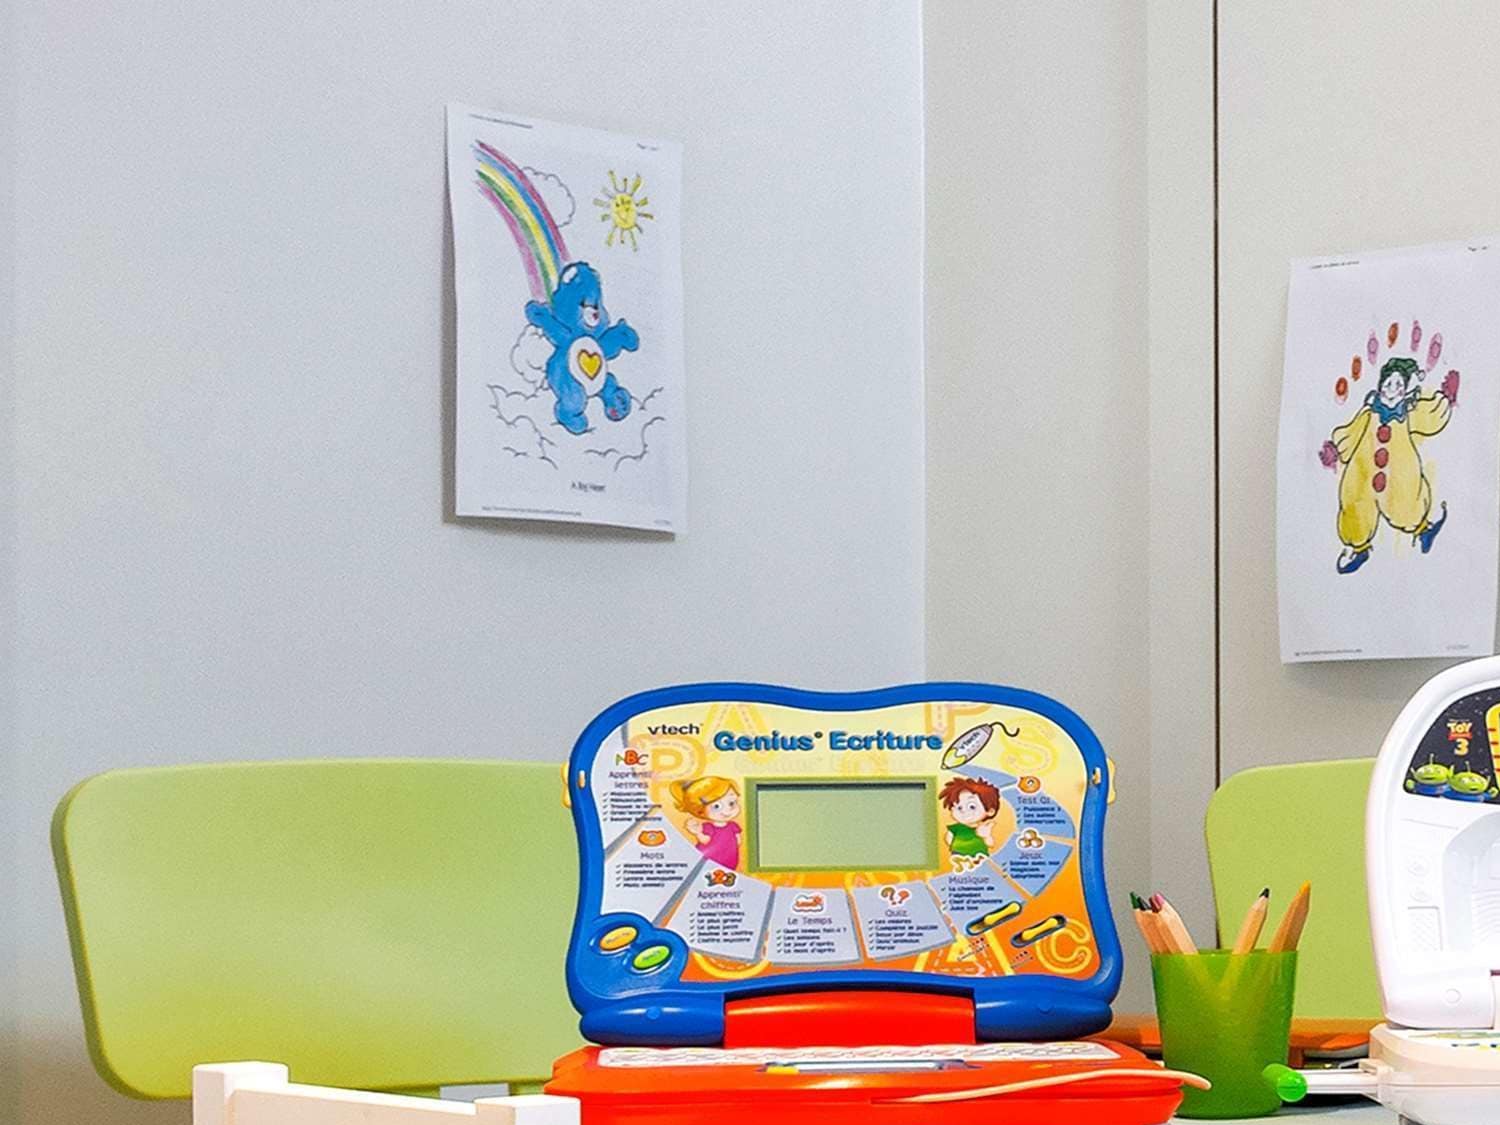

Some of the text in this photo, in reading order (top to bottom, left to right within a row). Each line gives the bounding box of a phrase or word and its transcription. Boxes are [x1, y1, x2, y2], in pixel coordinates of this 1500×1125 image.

[648, 723, 700, 735] vtech
[1447, 721, 1473, 734] TOY
[713, 730, 944, 751] Genius Ecriture
[1454, 738, 1470, 756] 3
